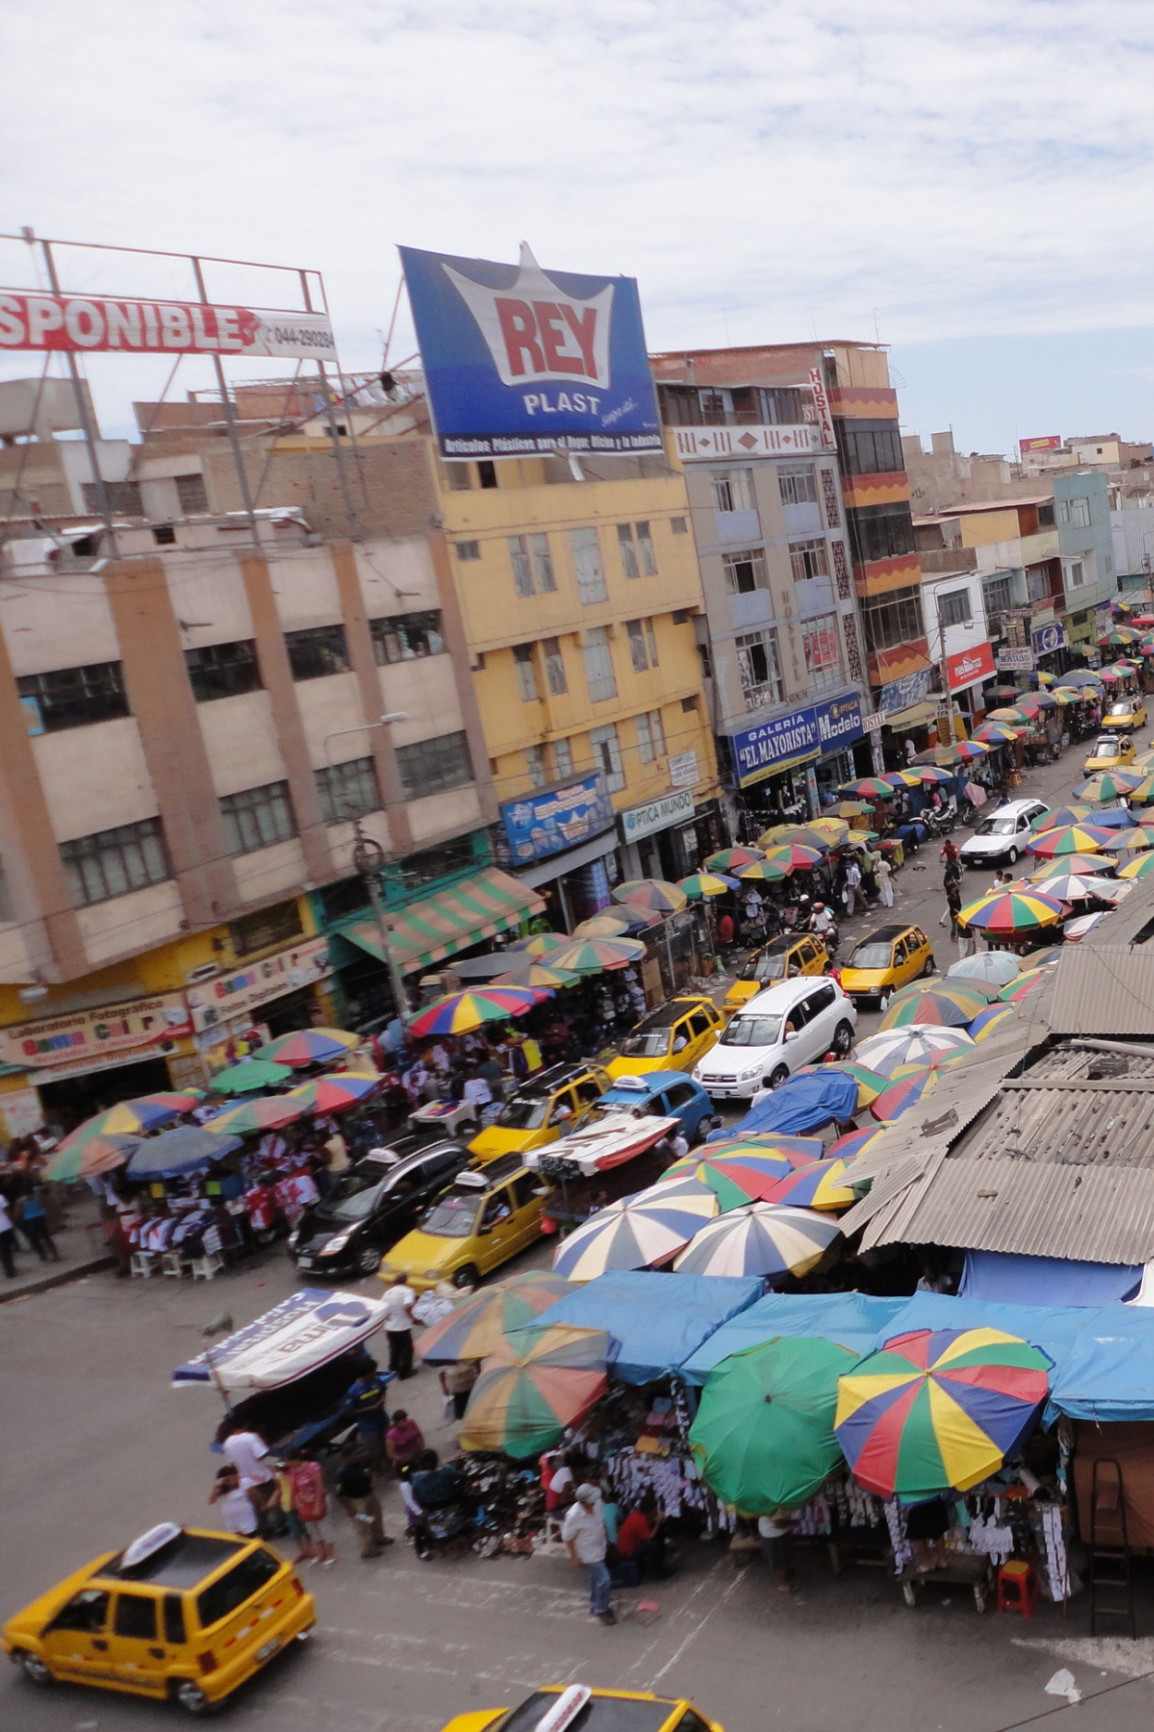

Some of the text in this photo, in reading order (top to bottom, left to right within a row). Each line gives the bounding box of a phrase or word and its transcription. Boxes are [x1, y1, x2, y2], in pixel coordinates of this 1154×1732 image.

[0, 298, 243, 349] SPONIBLE
[493, 297, 599, 380] REY
[522, 392, 601, 416] PLAST
[808, 368, 834, 446] HOSTAL
[747, 714, 805, 742] GALERÍA
[818, 713, 862, 742] Modelo
[660, 792, 692, 818] MUNDO
[8, 1017, 86, 1040] Laboratorio
